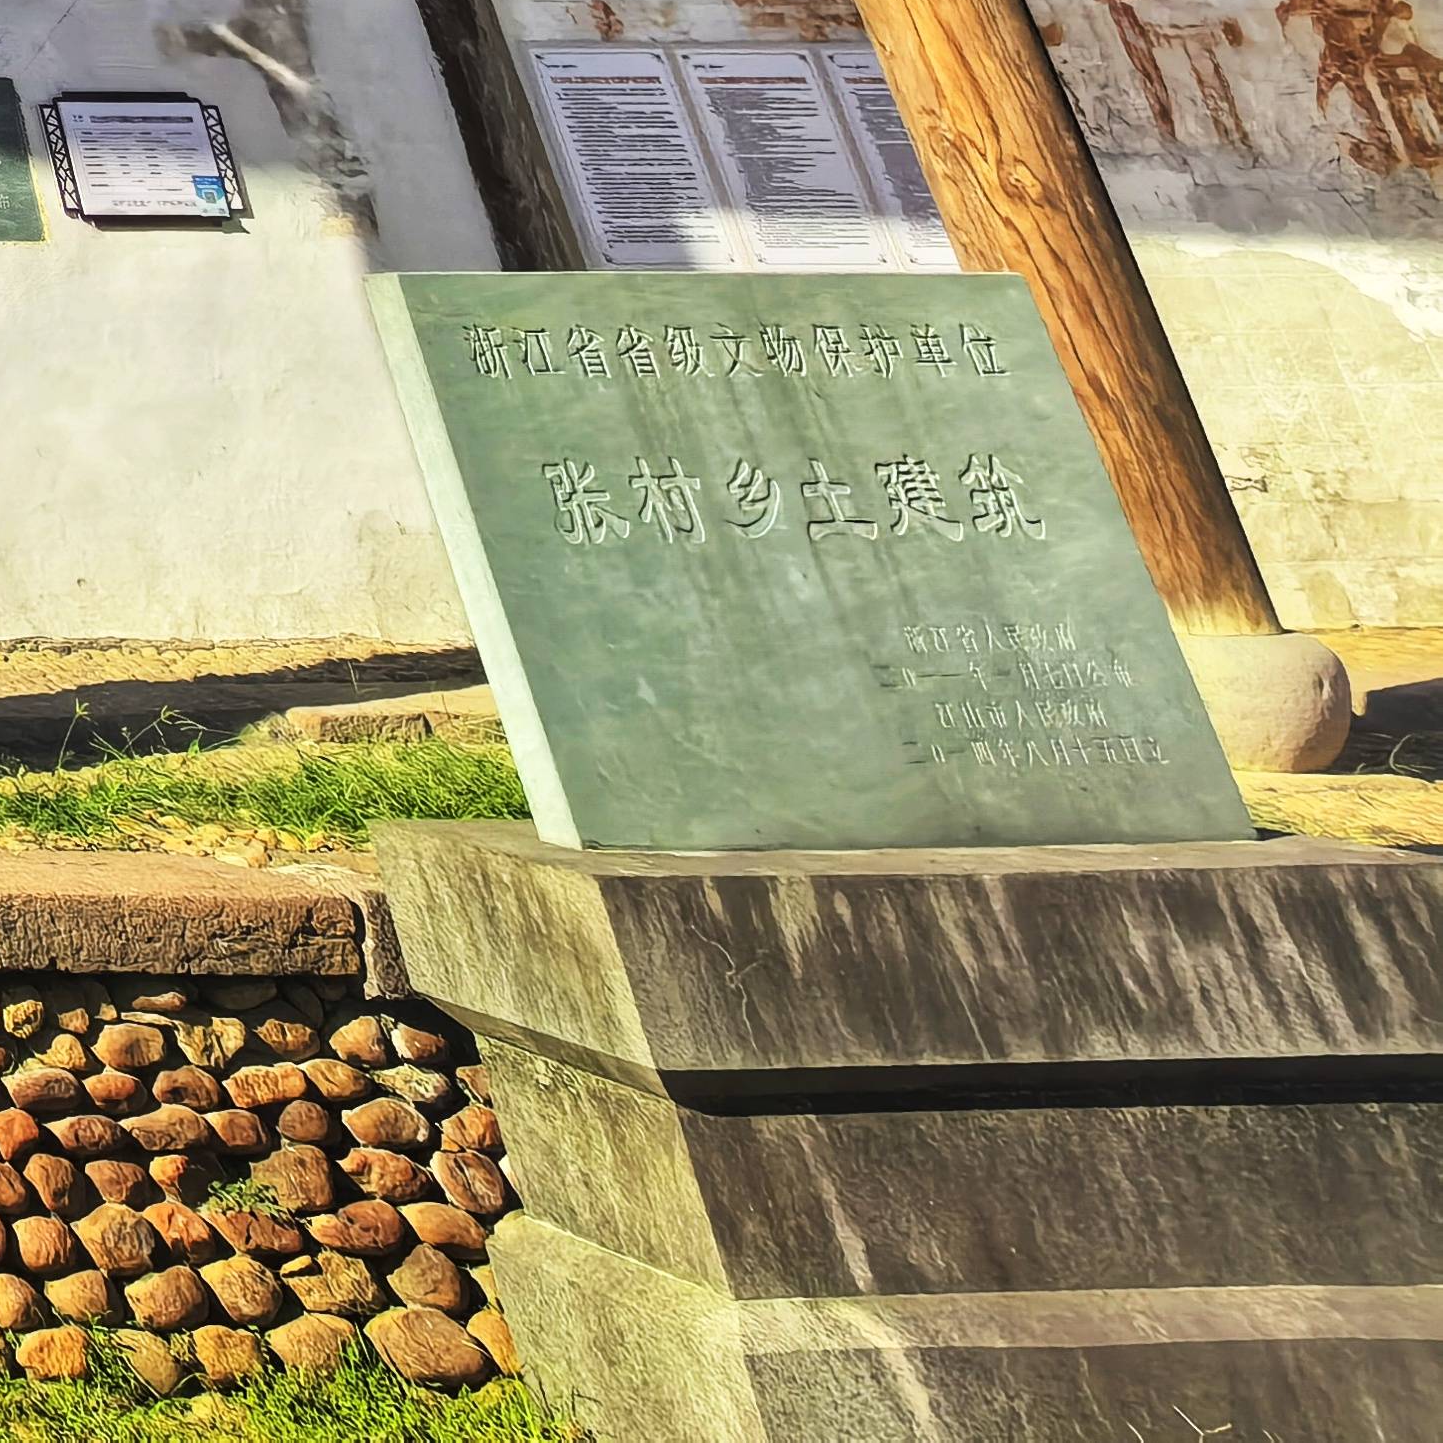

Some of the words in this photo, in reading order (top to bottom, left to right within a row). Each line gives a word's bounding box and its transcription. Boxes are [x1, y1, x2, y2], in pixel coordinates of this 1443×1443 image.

[464, 322, 1011, 379] 浙江省省级文物保护单位
[542, 453, 1047, 545] 张村乡土建筑
